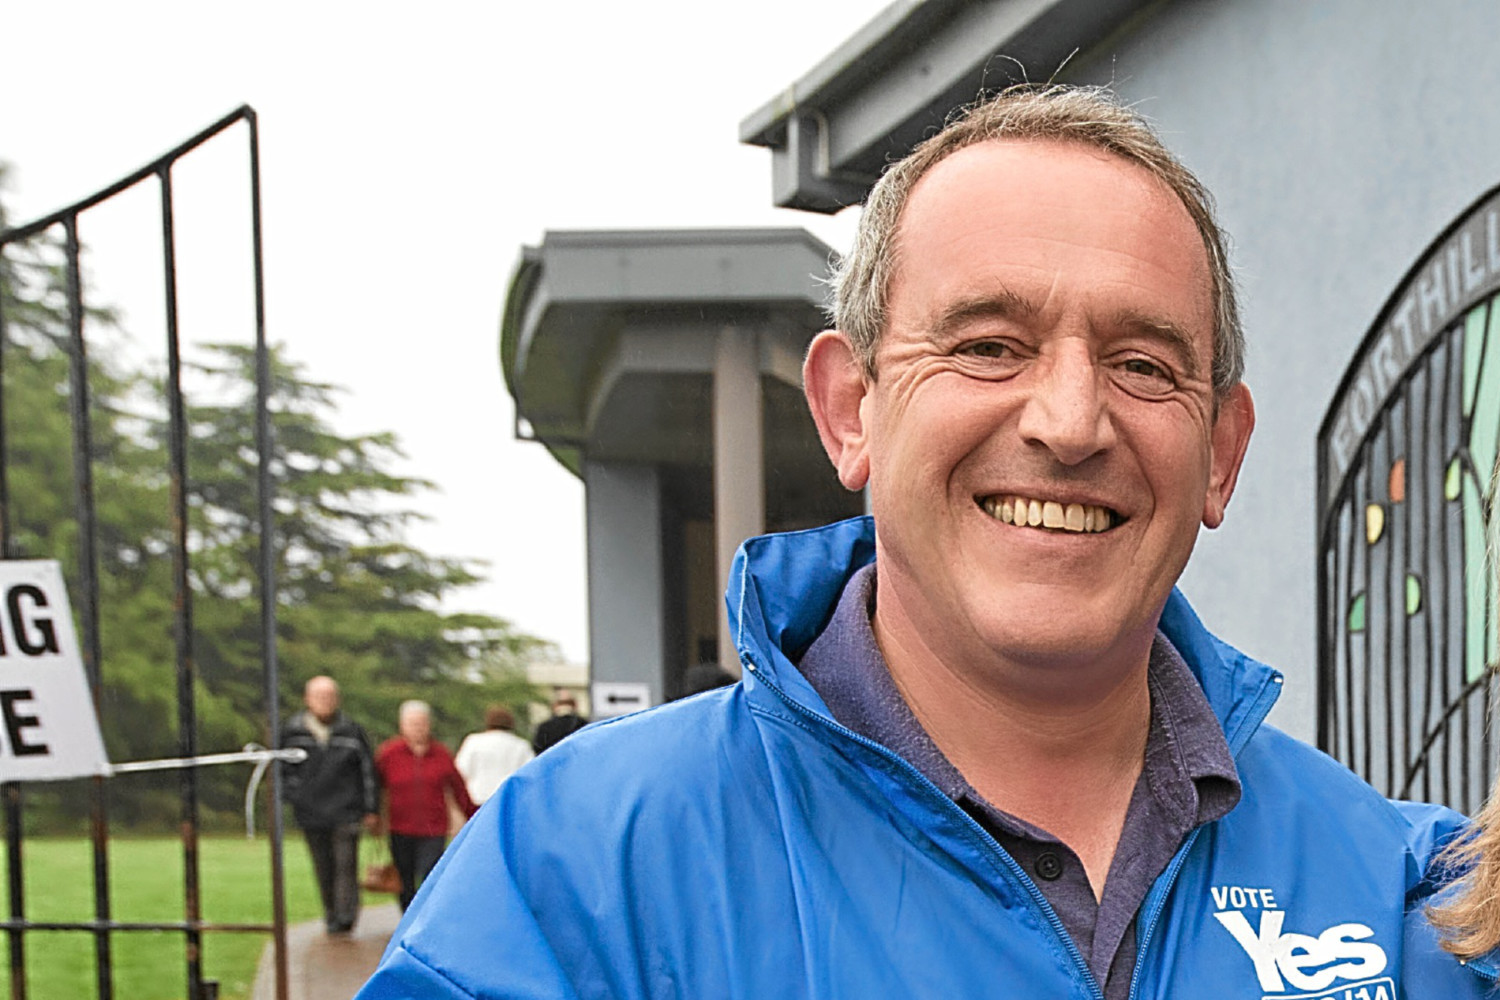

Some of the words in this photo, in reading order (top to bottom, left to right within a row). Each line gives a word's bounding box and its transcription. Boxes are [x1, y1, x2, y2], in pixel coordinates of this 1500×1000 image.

[0, 583, 60, 657] G
[1211, 886, 1278, 909] VOTE
[1214, 911, 1387, 992] Yes
